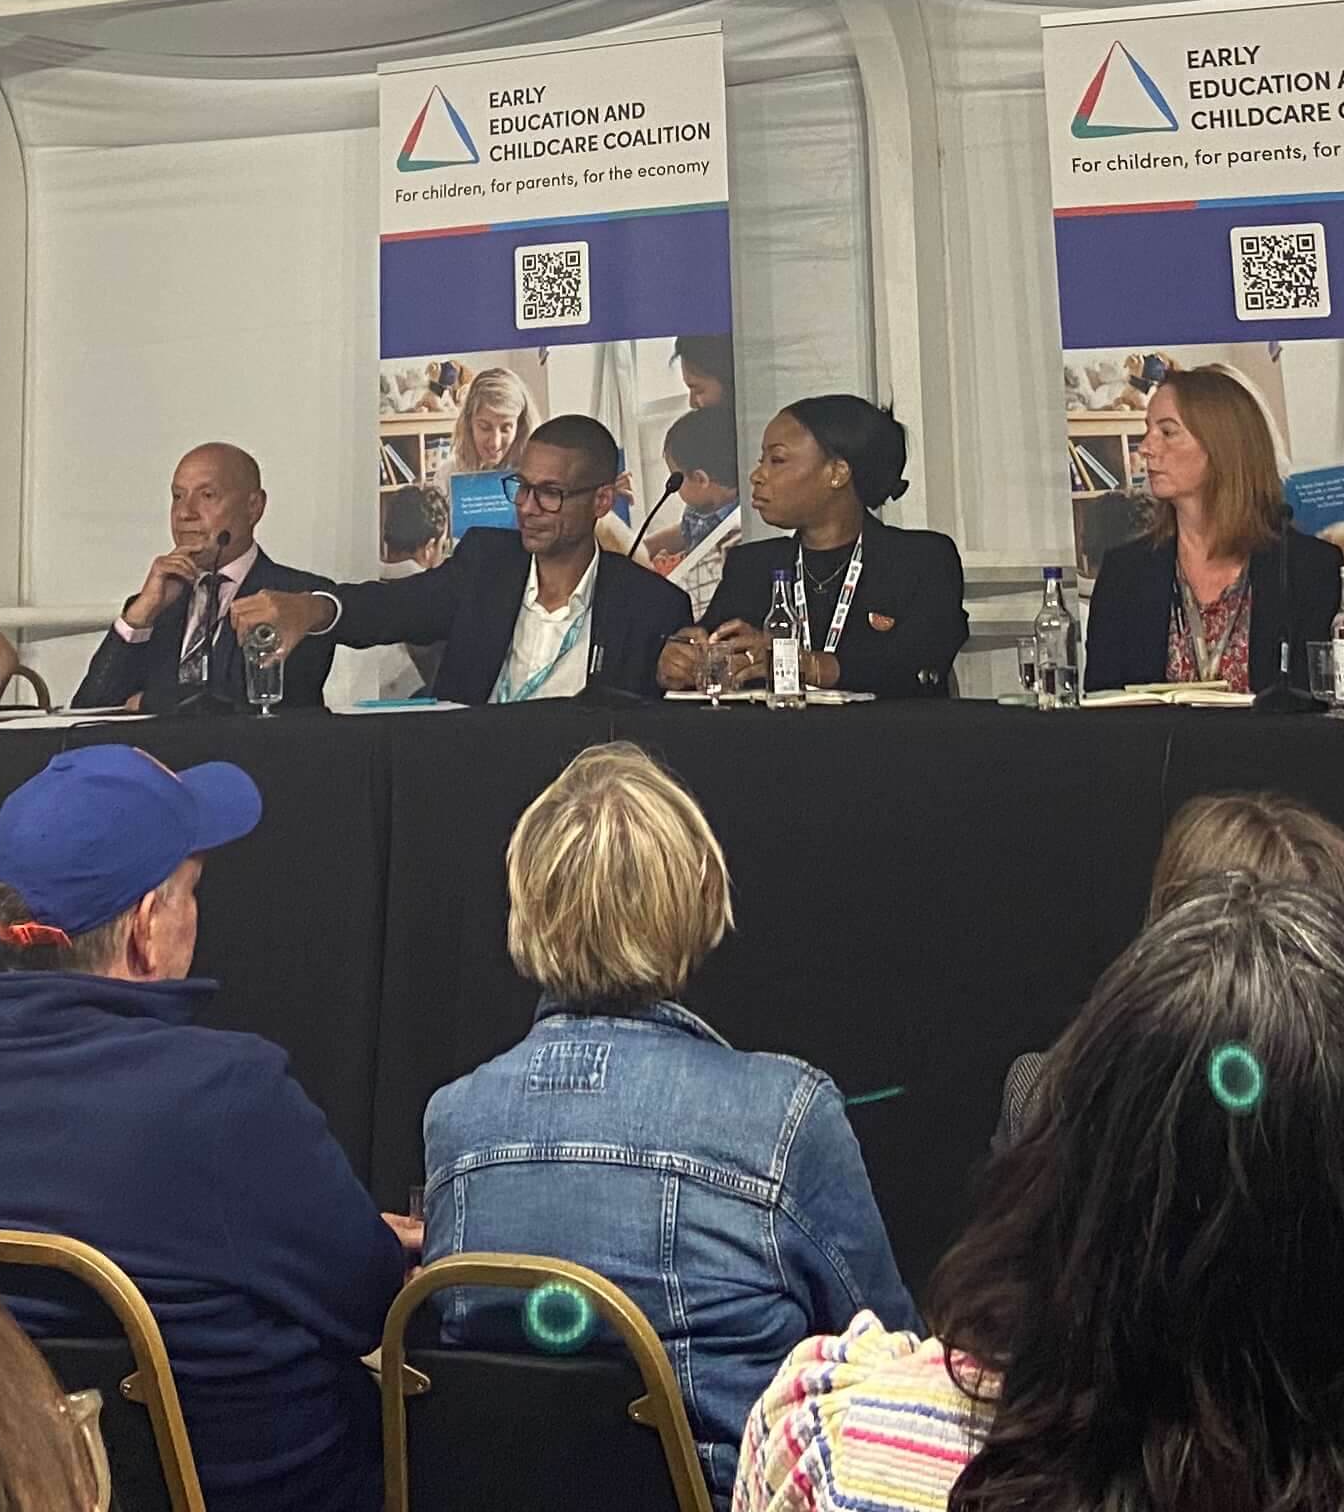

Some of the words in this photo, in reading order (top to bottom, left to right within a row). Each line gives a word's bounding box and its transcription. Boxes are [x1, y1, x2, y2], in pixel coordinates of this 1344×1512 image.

[1187, 45, 1260, 69] EARLY
[489, 85, 547, 109] EARLY
[1189, 72, 1331, 100] EDUCATION
[489, 108, 600, 135] EDUCATION
[604, 101, 646, 122] AND
[1191, 102, 1331, 130] CHILDCARE
[489, 135, 599, 162] CHILDCARE
[603, 122, 711, 149] COALITION
[1072, 156, 1102, 174] For
[1107, 151, 1189, 172] children,
[1194, 148, 1222, 166] for
[1227, 143, 1308, 168] parents,
[1313, 140, 1341, 159] for
[395, 188, 419, 203] For
[422, 182, 486, 201] children,
[491, 178, 512, 193] for
[516, 173, 579, 194] parents,
[583, 169, 605, 185] for
[609, 166, 633, 181] the
[638, 159, 710, 180] economy
